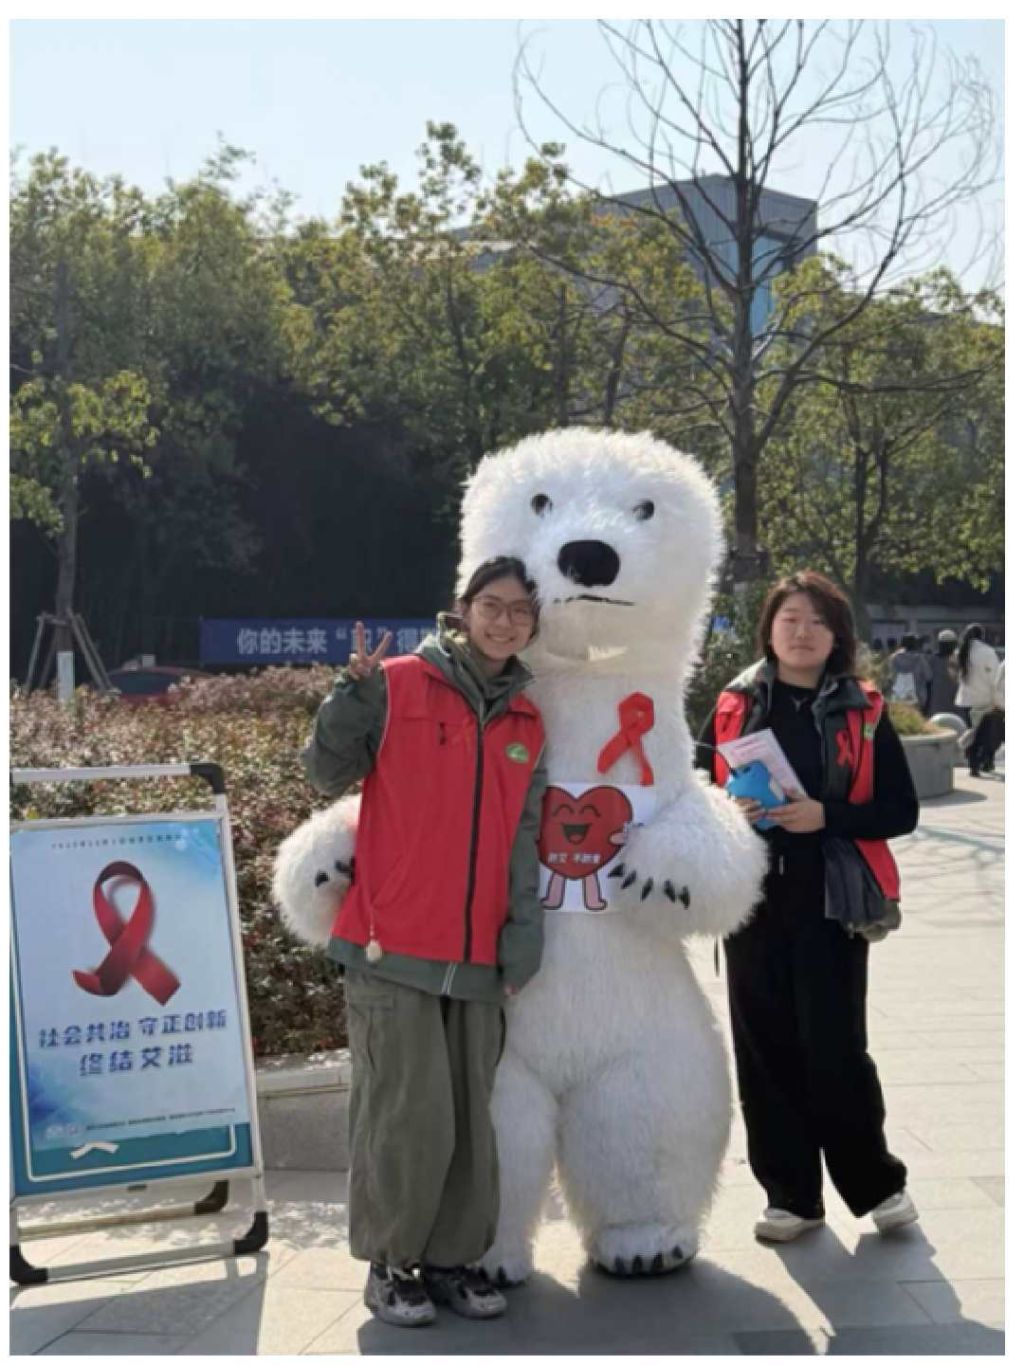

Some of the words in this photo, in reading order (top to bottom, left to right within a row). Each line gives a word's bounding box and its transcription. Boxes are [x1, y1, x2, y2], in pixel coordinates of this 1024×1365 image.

[39, 1020, 131, 1048] 社会共治
[138, 1009, 227, 1036] 守正创新
[79, 1042, 193, 1076] 终结艾滋
